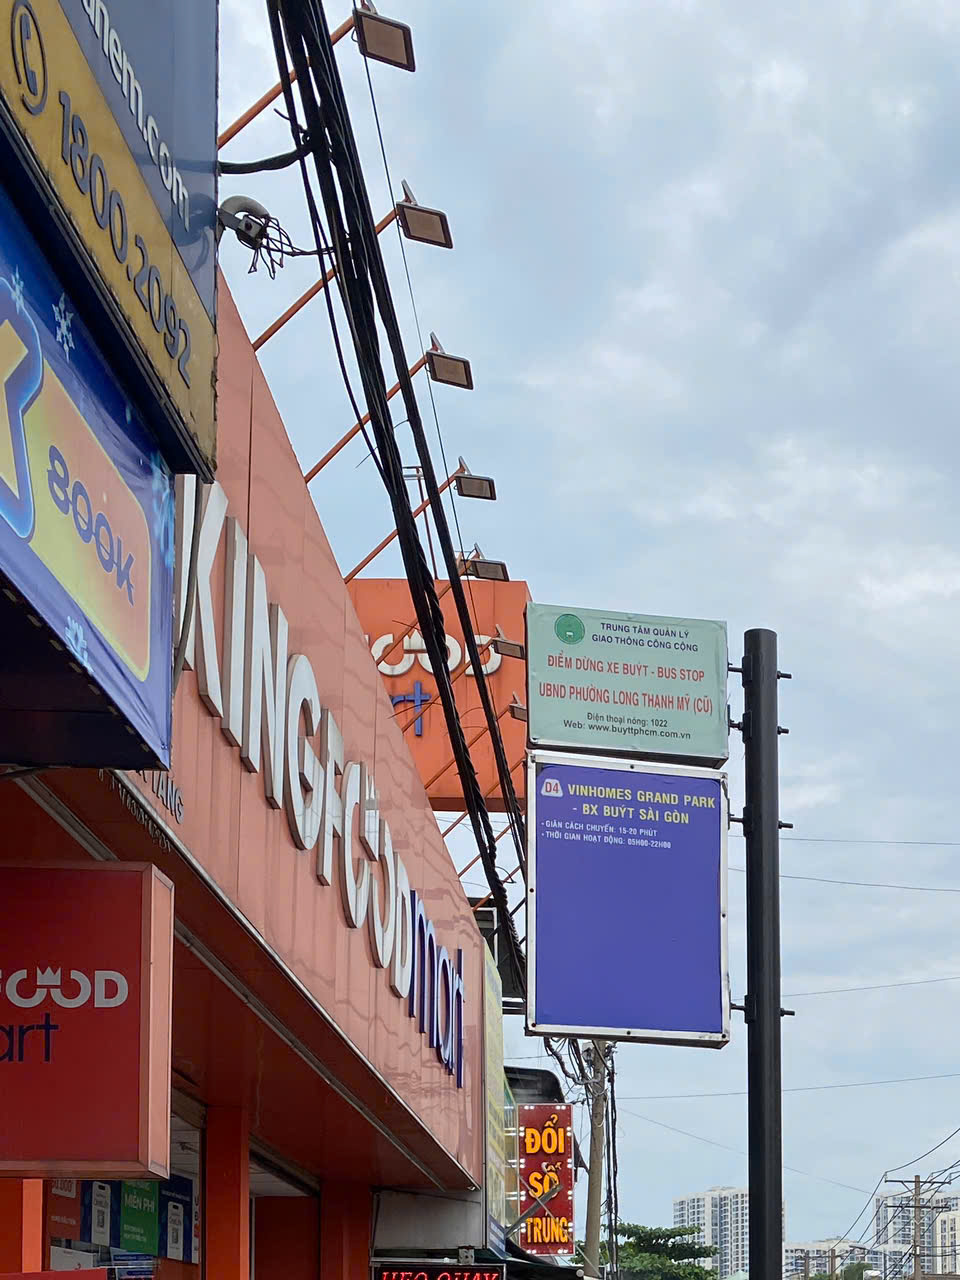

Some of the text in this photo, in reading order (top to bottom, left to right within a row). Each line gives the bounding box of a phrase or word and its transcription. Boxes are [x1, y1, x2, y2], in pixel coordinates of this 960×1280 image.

[58, 90, 192, 389] 1800.2092
[601, 623, 689, 639] TRUNG TÂM QUẢN LÝ
[592, 634, 698, 652] GIAO THÔNG CÔNG CỘNG
[548, 650, 572, 669] ĐIỂM
[575, 656, 604, 673] DỪNG
[607, 662, 619, 674] XE
[658, 666, 677, 679] BUS
[680, 669, 704, 682] STOP
[539, 682, 566, 699] UBND
[569, 684, 610, 704] PHƯỜNG
[613, 690, 639, 706] LONG
[642, 693, 674, 712] THẠNH
[563, 720, 691, 740] Web: www.buyttphcm.com.vn
[587, 713, 668, 728] Điện thoại nóng: 1022
[545, 782, 559, 793] D4
[568, 784, 716, 809] VINHOMES GRAND PARK
[582, 803, 689, 824] BX BUÝT SÀI GÒN
[564, 832, 581, 841] GIAN
[583, 834, 601, 844] HOẠT
[565, 821, 584, 831] CÁCH
[619, 827, 637, 835] 15-20
[639, 826, 657, 837] PHÚT
[410, 889, 466, 1088] mart
[524, 1113, 565, 1155] ĐỔI
[525, 1211, 569, 1244] TRÚNG
